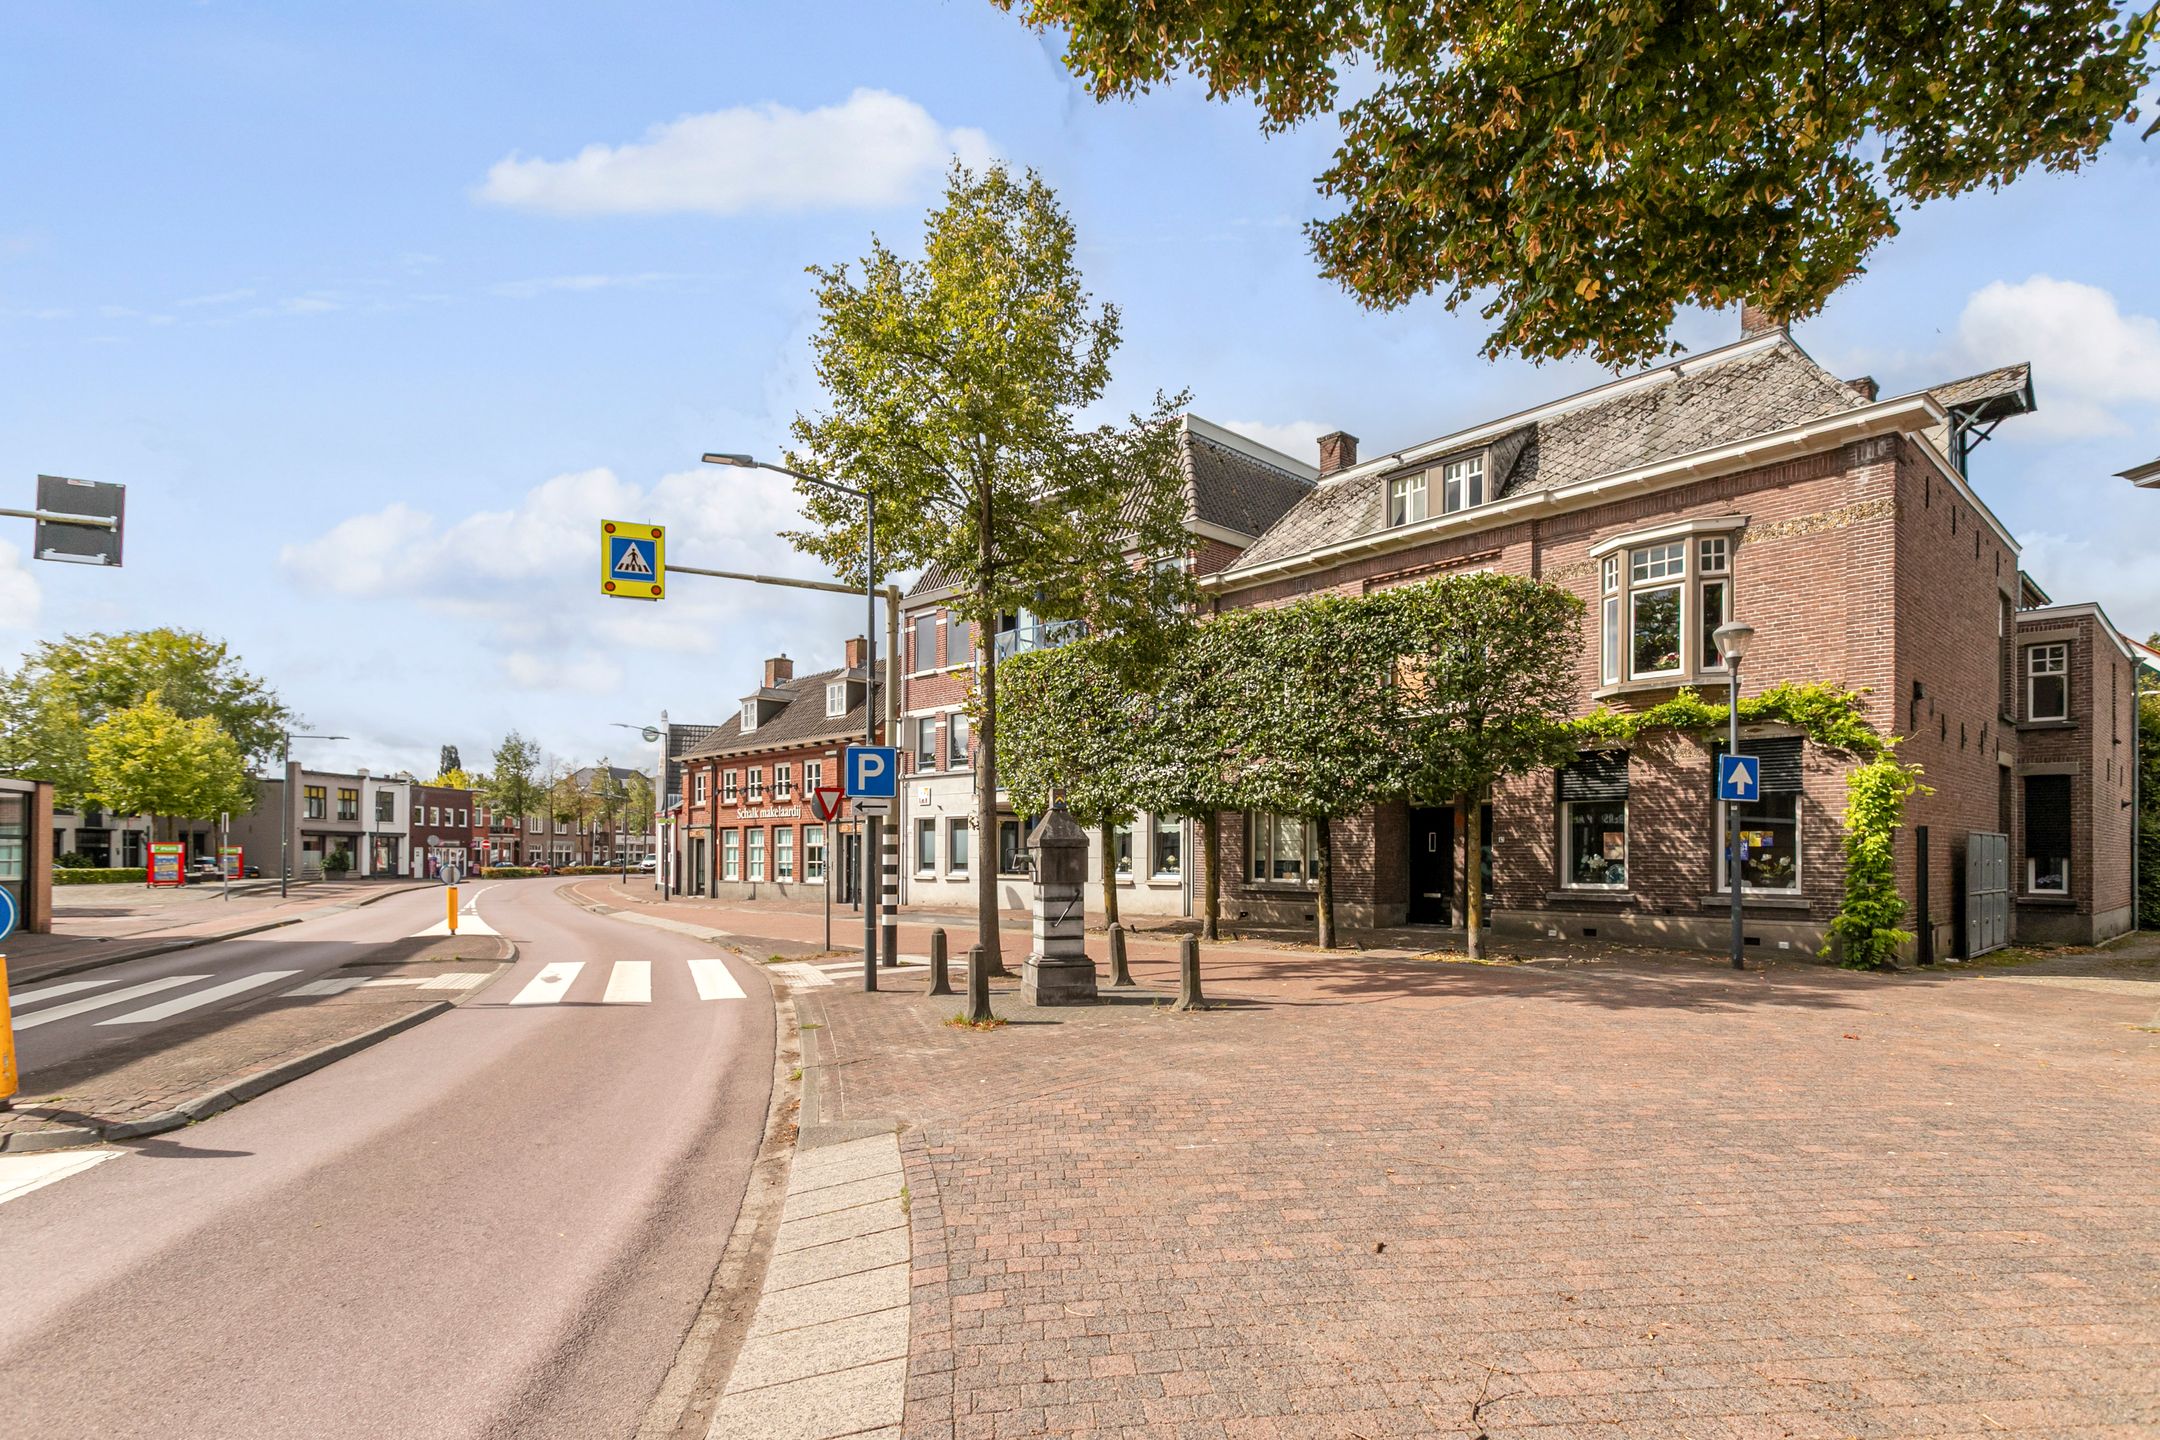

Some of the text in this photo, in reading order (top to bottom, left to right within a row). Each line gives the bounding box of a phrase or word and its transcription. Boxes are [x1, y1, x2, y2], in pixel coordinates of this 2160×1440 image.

[858, 753, 885, 791] P
[736, 805, 801, 819] Schalk makelaardij
